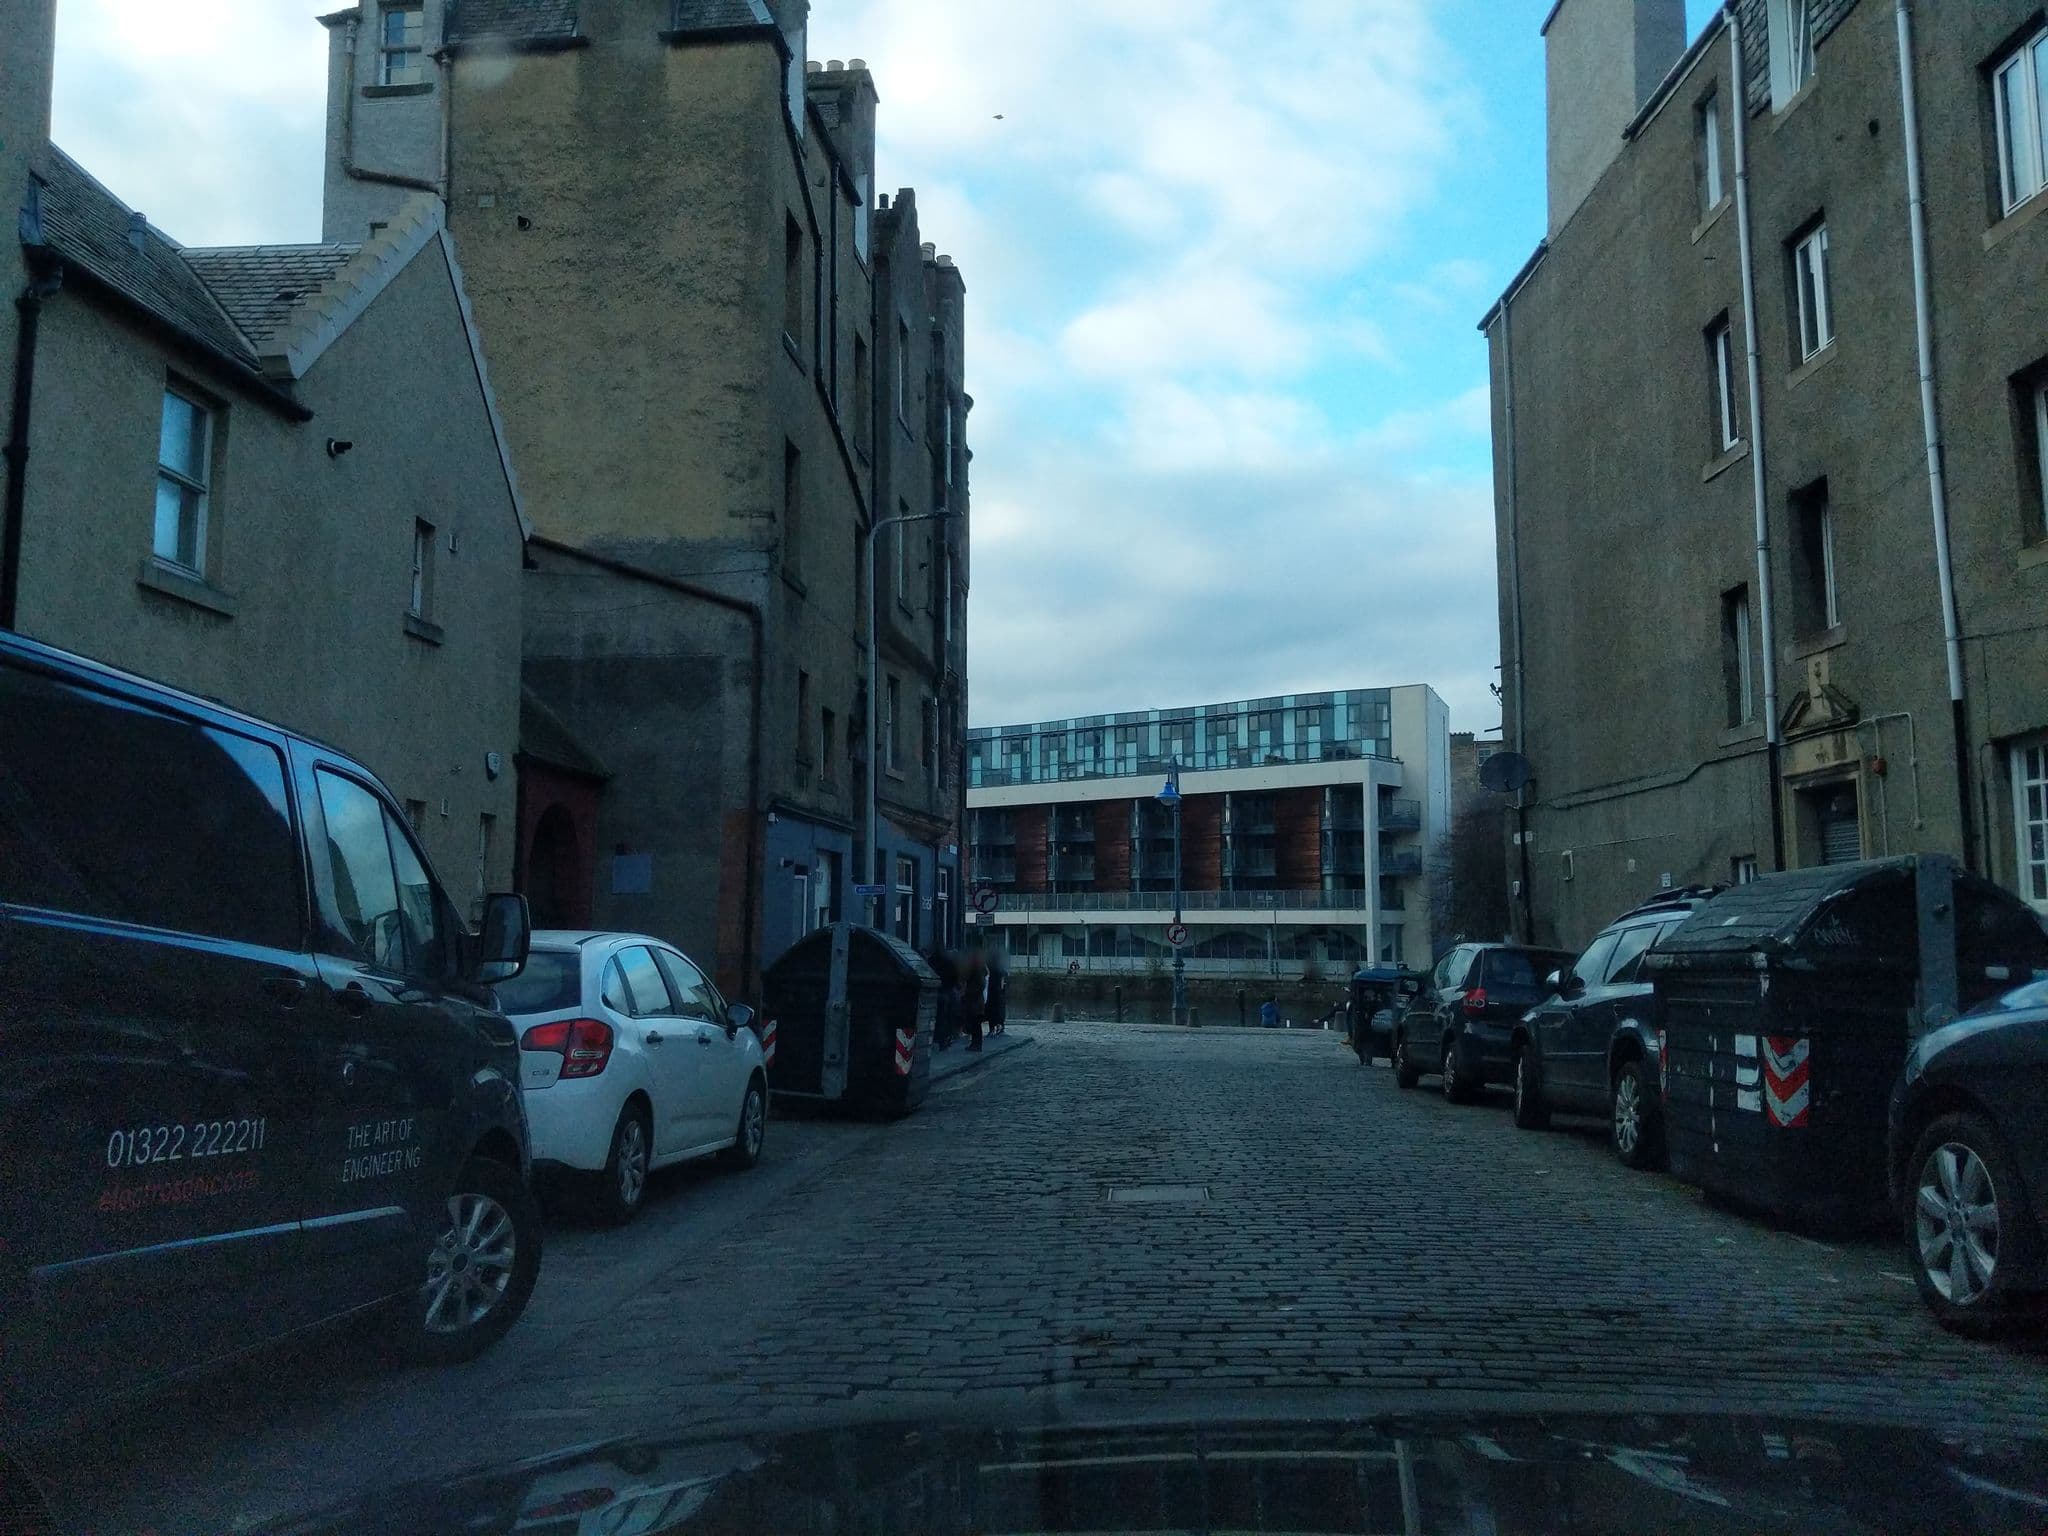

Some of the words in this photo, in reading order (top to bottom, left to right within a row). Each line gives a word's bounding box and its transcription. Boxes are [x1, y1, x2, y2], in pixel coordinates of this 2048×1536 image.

[107, 1125, 185, 1167] 01322
[191, 1117, 265, 1157] 222211
[348, 1124, 371, 1150] THE
[373, 1120, 397, 1145] ART
[398, 1118, 414, 1141] OF
[342, 1145, 422, 1182] ENGINEERNG
